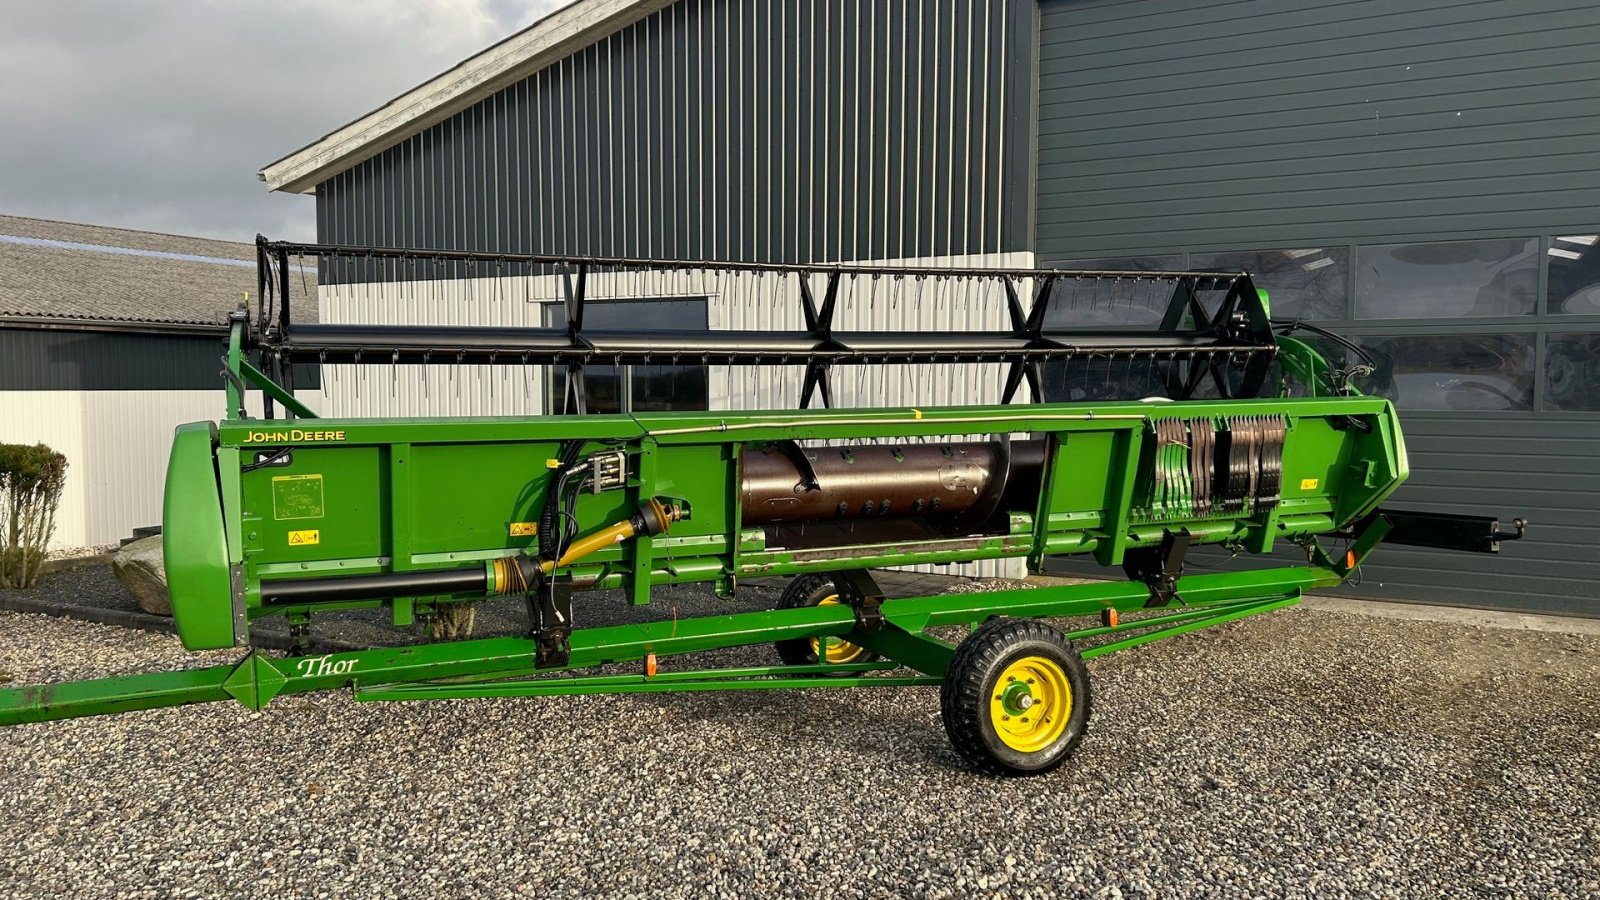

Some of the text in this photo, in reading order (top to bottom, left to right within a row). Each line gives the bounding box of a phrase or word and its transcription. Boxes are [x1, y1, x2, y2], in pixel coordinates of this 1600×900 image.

[243, 430, 346, 443] JOHN DEERE
[297, 654, 359, 677] Thor
